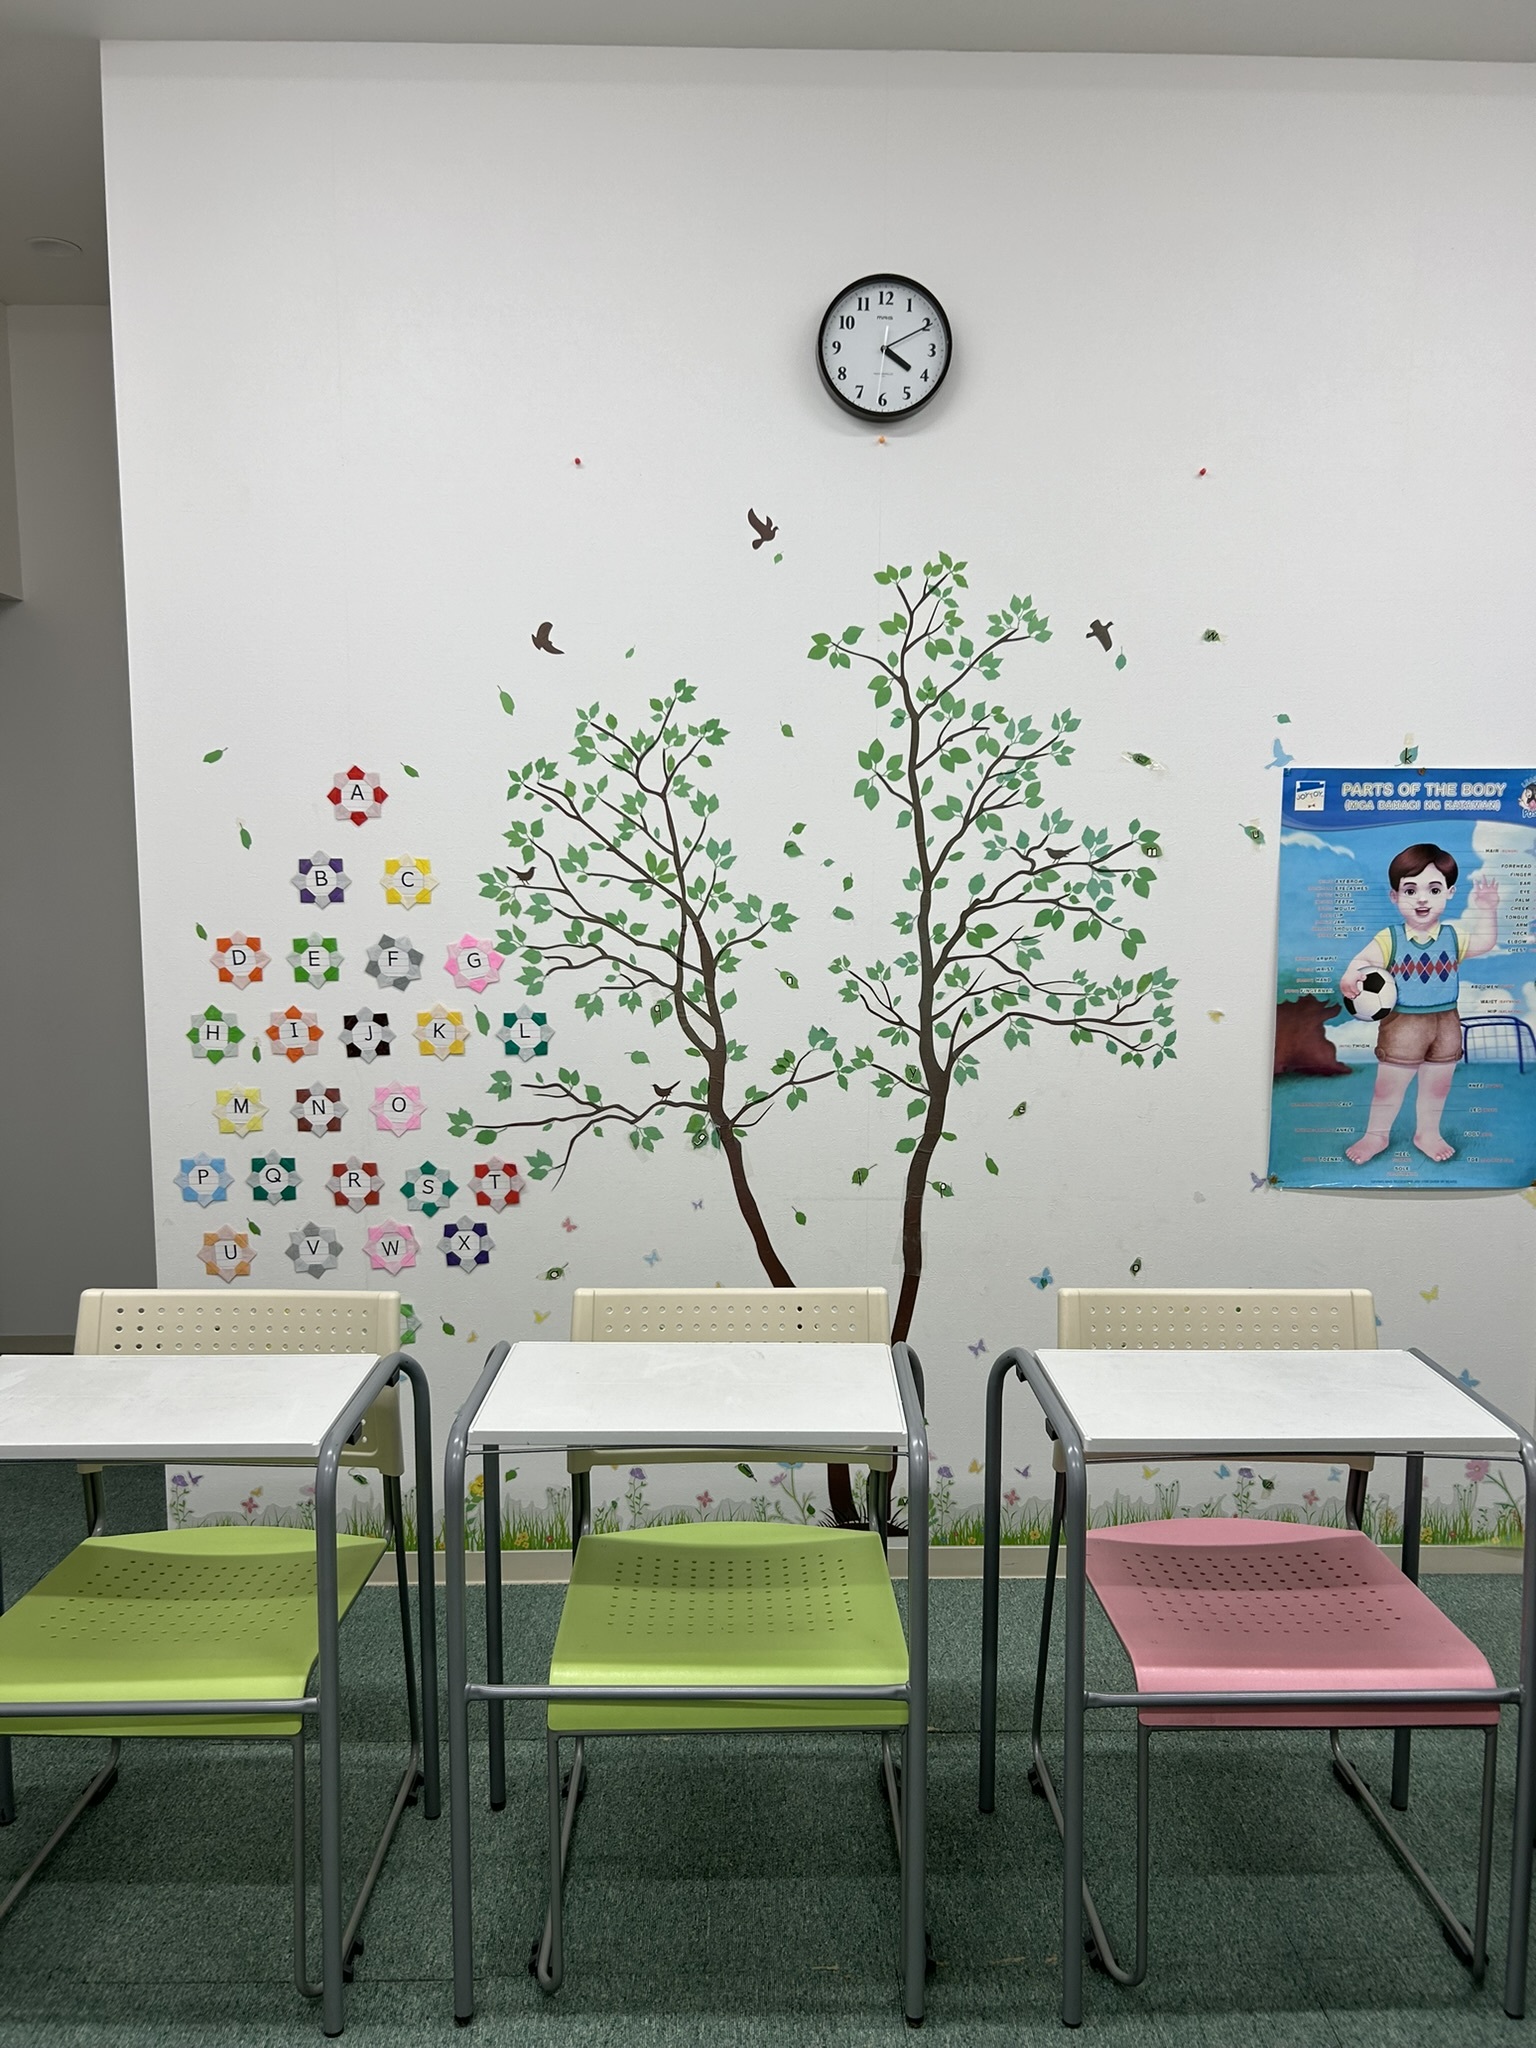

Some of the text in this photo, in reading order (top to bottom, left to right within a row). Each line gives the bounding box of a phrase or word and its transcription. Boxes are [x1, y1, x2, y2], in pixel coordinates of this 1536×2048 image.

[857, 297, 870, 311] 11
[879, 291, 894, 305] 12
[907, 298, 912, 312] 1
[839, 315, 855, 330] 10
[922, 317, 932, 332] 2
[832, 341, 841, 355] 9
[928, 343, 937, 357] 3
[837, 367, 847, 380] 8
[920, 368, 929, 382] 4
[855, 385, 864, 399] 7
[878, 392, 888, 406] 6
[903, 386, 911, 400] 5
[1404, 747, 1412, 764] k
[351, 785, 364, 800] A
[1341, 782, 1507, 797] PARTS OF THE BODY
[1344, 799, 1375, 812] (MGA
[1423, 799, 1442, 811] NG
[315, 871, 328, 886] B
[402, 872, 414, 887] C
[232, 950, 246, 965] D
[309, 951, 320, 966] E
[389, 951, 398, 966] F
[468, 953, 481, 968] G
[207, 1025, 219, 1040] H
[290, 1022, 298, 1037] I
[365, 1026, 372, 1041] J
[434, 1023, 445, 1038] K
[520, 1023, 530, 1038] L
[234, 1098, 248, 1113] M
[312, 1100, 325, 1115] N
[392, 1097, 406, 1112] O
[198, 1170, 209, 1184] P
[266, 1168, 281, 1183] Q
[349, 1173, 361, 1187] R
[489, 1174, 501, 1189] T
[423, 1180, 434, 1194] S
[307, 1240, 319, 1255] V
[382, 1240, 399, 1256] W
[459, 1236, 470, 1250] X
[225, 1245, 237, 1259] U
